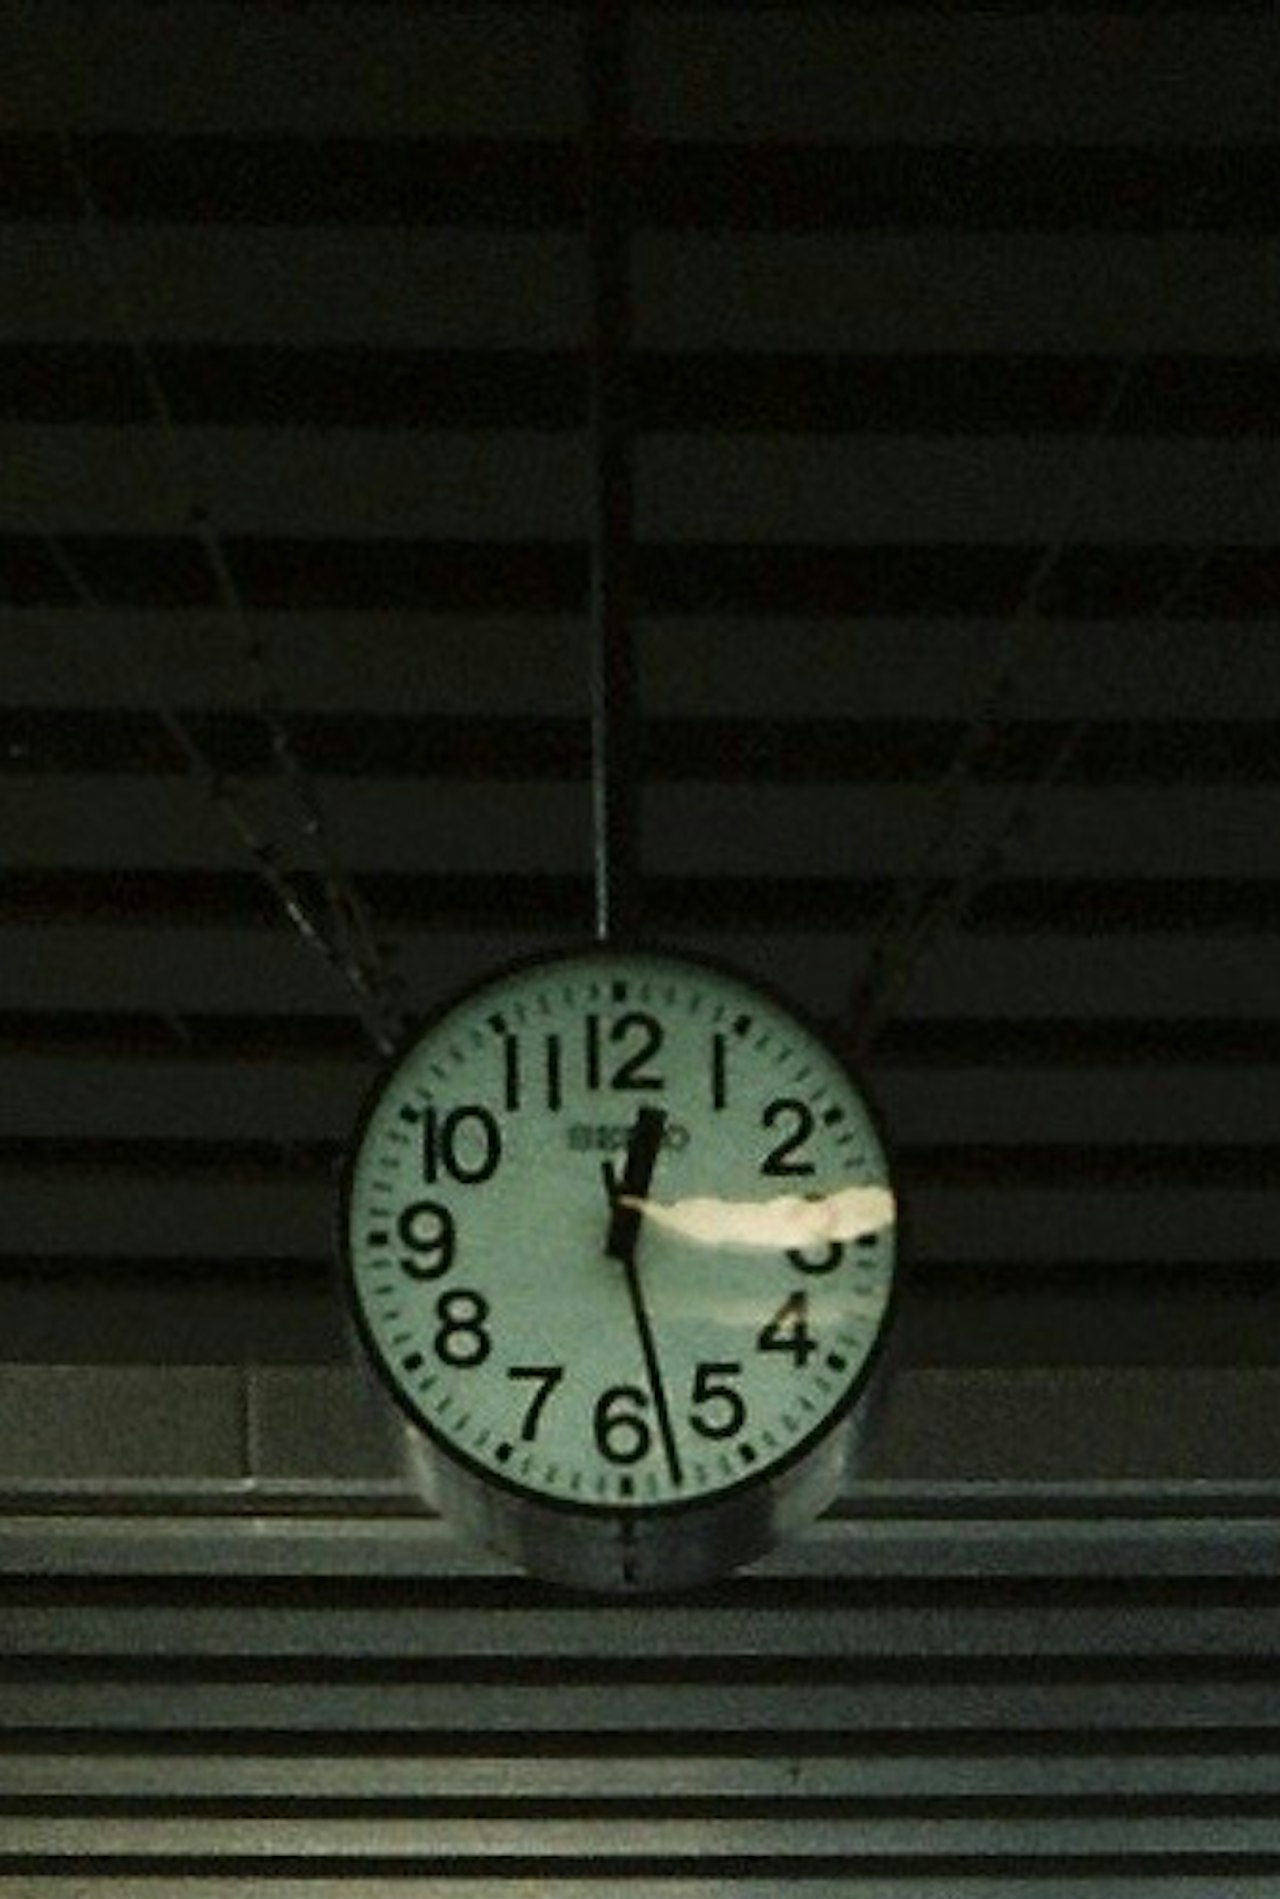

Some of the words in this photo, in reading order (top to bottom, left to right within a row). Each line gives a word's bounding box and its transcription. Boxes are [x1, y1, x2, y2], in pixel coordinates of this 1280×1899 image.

[506, 1034, 562, 1111] 11
[586, 1012, 664, 1090] 12
[713, 1034, 725, 1111] 1
[424, 1106, 501, 1184] 10
[761, 1099, 816, 1176] 2
[398, 1201, 455, 1281] 9
[434, 1289, 491, 1369] 8
[757, 1291, 818, 1368] 4
[507, 1366, 563, 1441] 7
[594, 1386, 651, 1465] 6
[690, 1363, 746, 1440] 5
